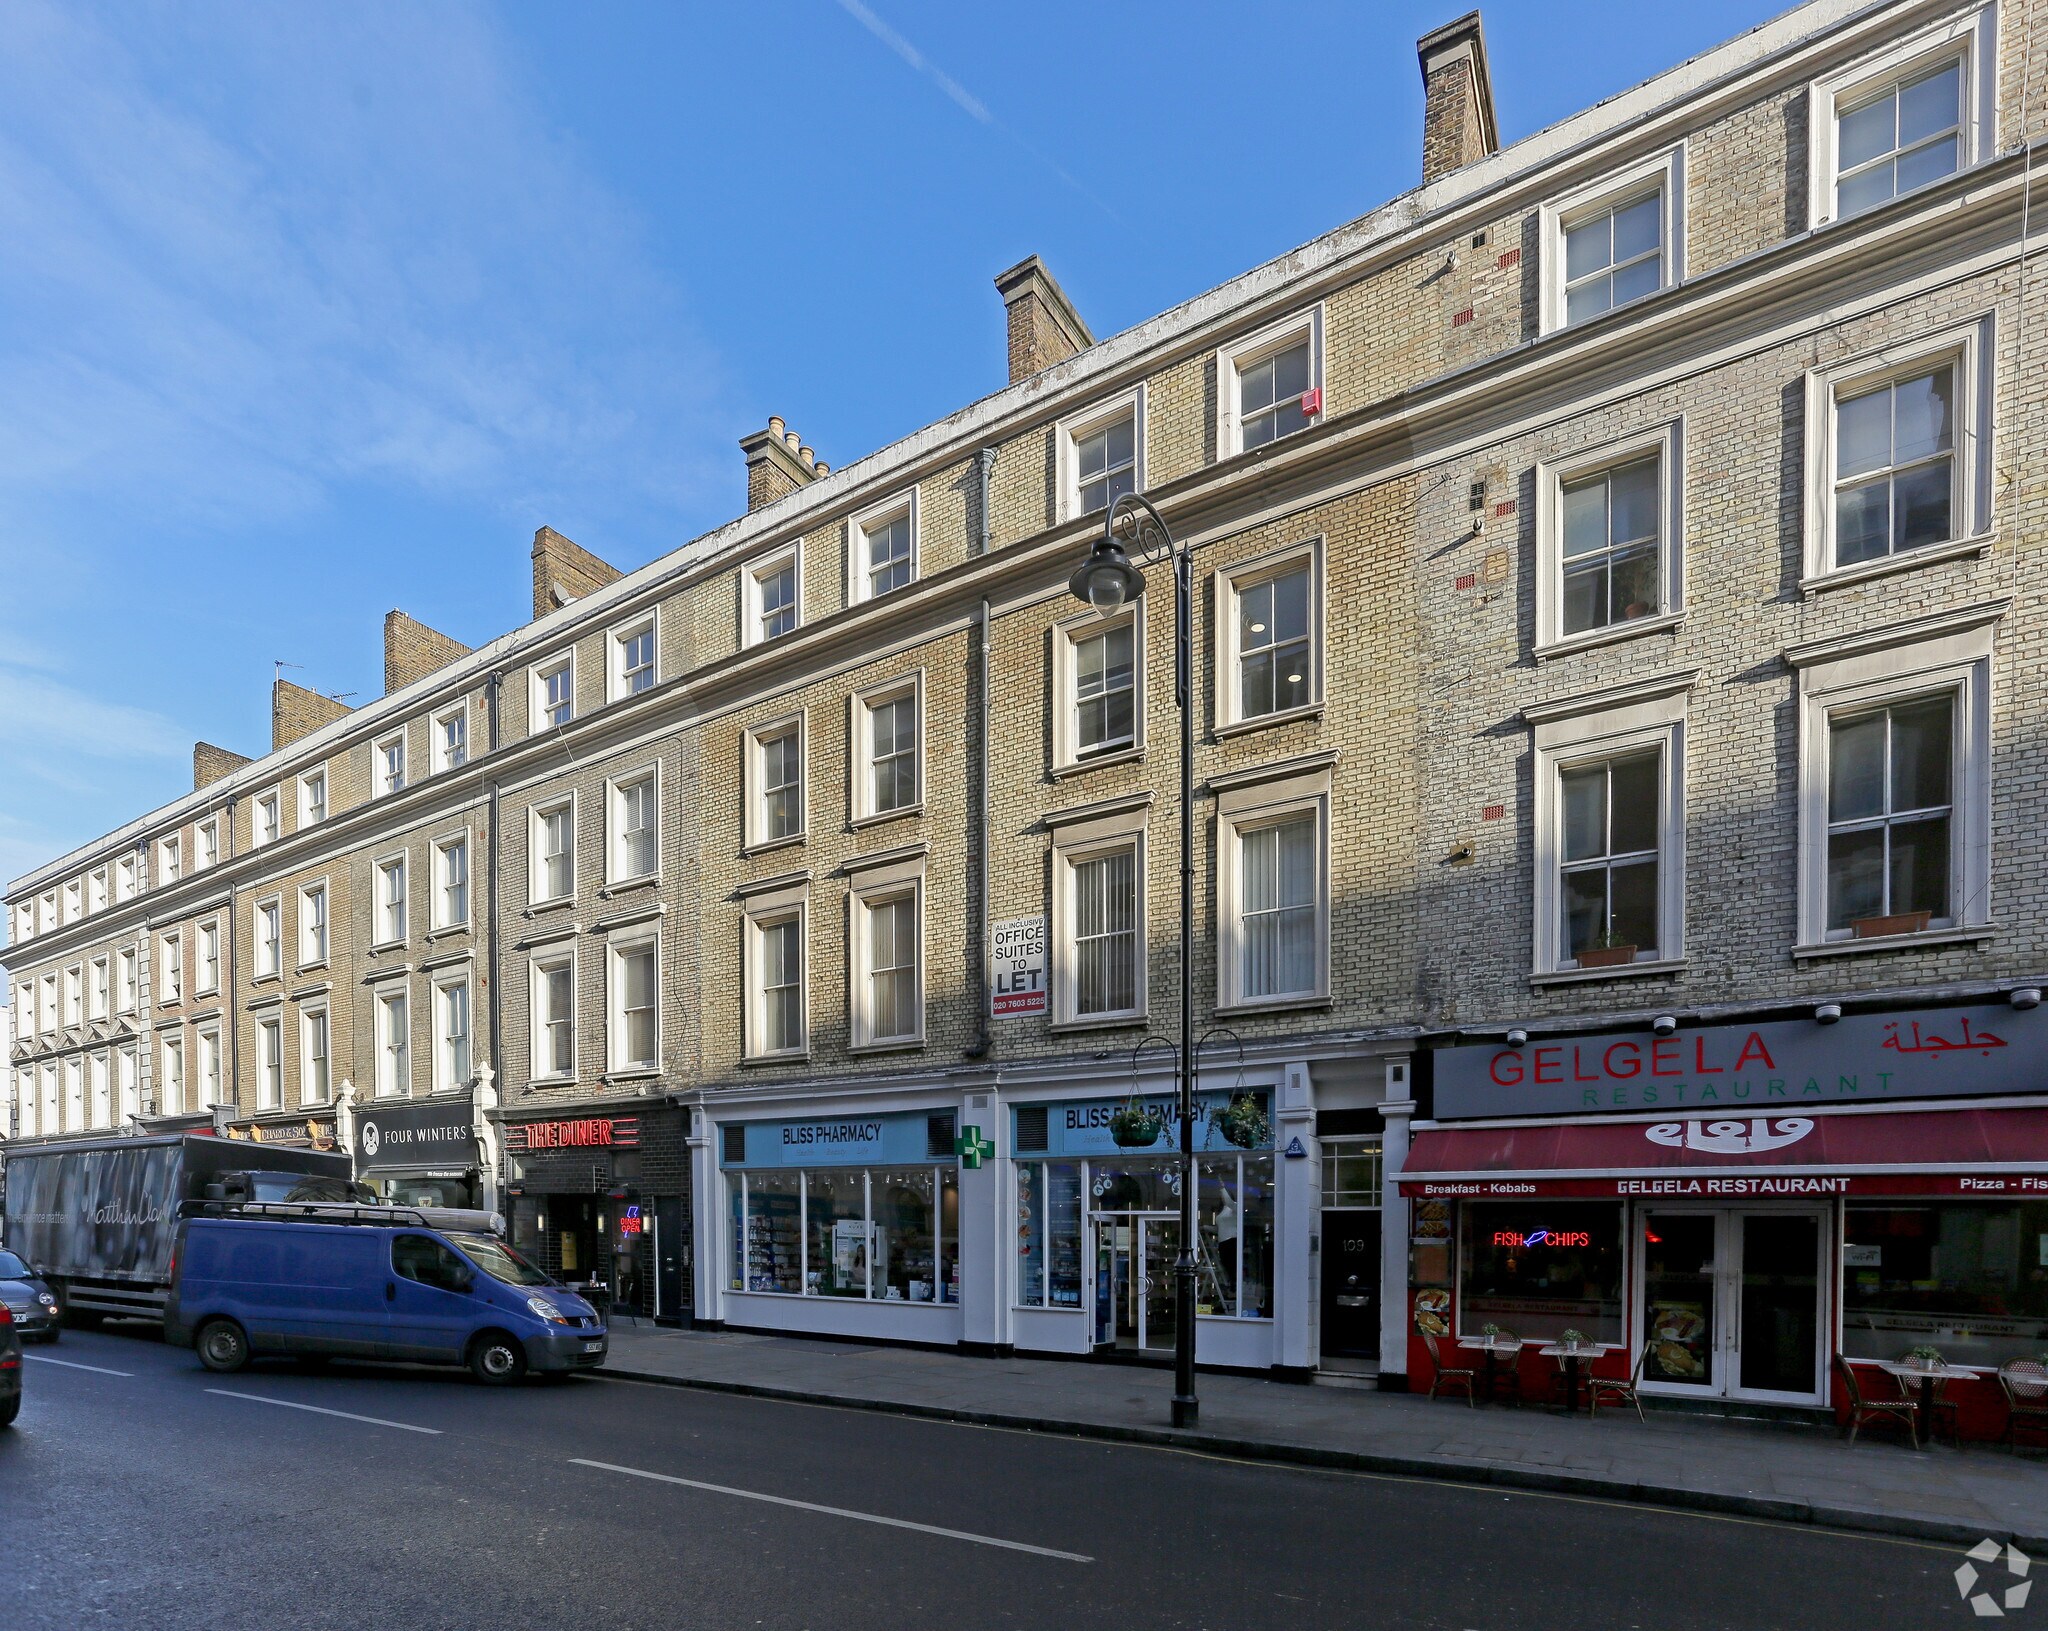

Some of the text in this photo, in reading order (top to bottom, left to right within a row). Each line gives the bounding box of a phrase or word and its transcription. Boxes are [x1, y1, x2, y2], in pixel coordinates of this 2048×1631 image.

[995, 924, 1008, 932] ALL
[995, 926, 1044, 945] OFFICE
[995, 941, 1044, 960] SUITES
[1011, 959, 1027, 971] TO
[997, 968, 1042, 994] LET
[993, 996, 1045, 1010] 020 7603 5225
[1881, 1017, 2008, 1057] جلجلة
[1489, 1031, 1776, 1087] GELGELA
[1582, 1072, 1894, 1106] RESTAURANT
[1066, 1107, 1110, 1129] BLISS
[385, 1125, 467, 1144] FOUR WINTERS
[525, 1119, 613, 1148] THE DINER
[783, 1123, 882, 1145] BLISS PHARMACY
[1424, 1183, 1480, 1194] Breakfast
[1490, 1182, 1536, 1193] Kebabs
[1617, 1178, 1850, 1194] GELGELA RESTAURANT
[1960, 1178, 2005, 1189] Pizza
[2022, 1178, 2048, 1189] Fis
[621, 1225, 641, 1233] OPEN
[1343, 1239, 1364, 1251] 109
[1494, 1232, 1589, 1247] FISH CHIPS
